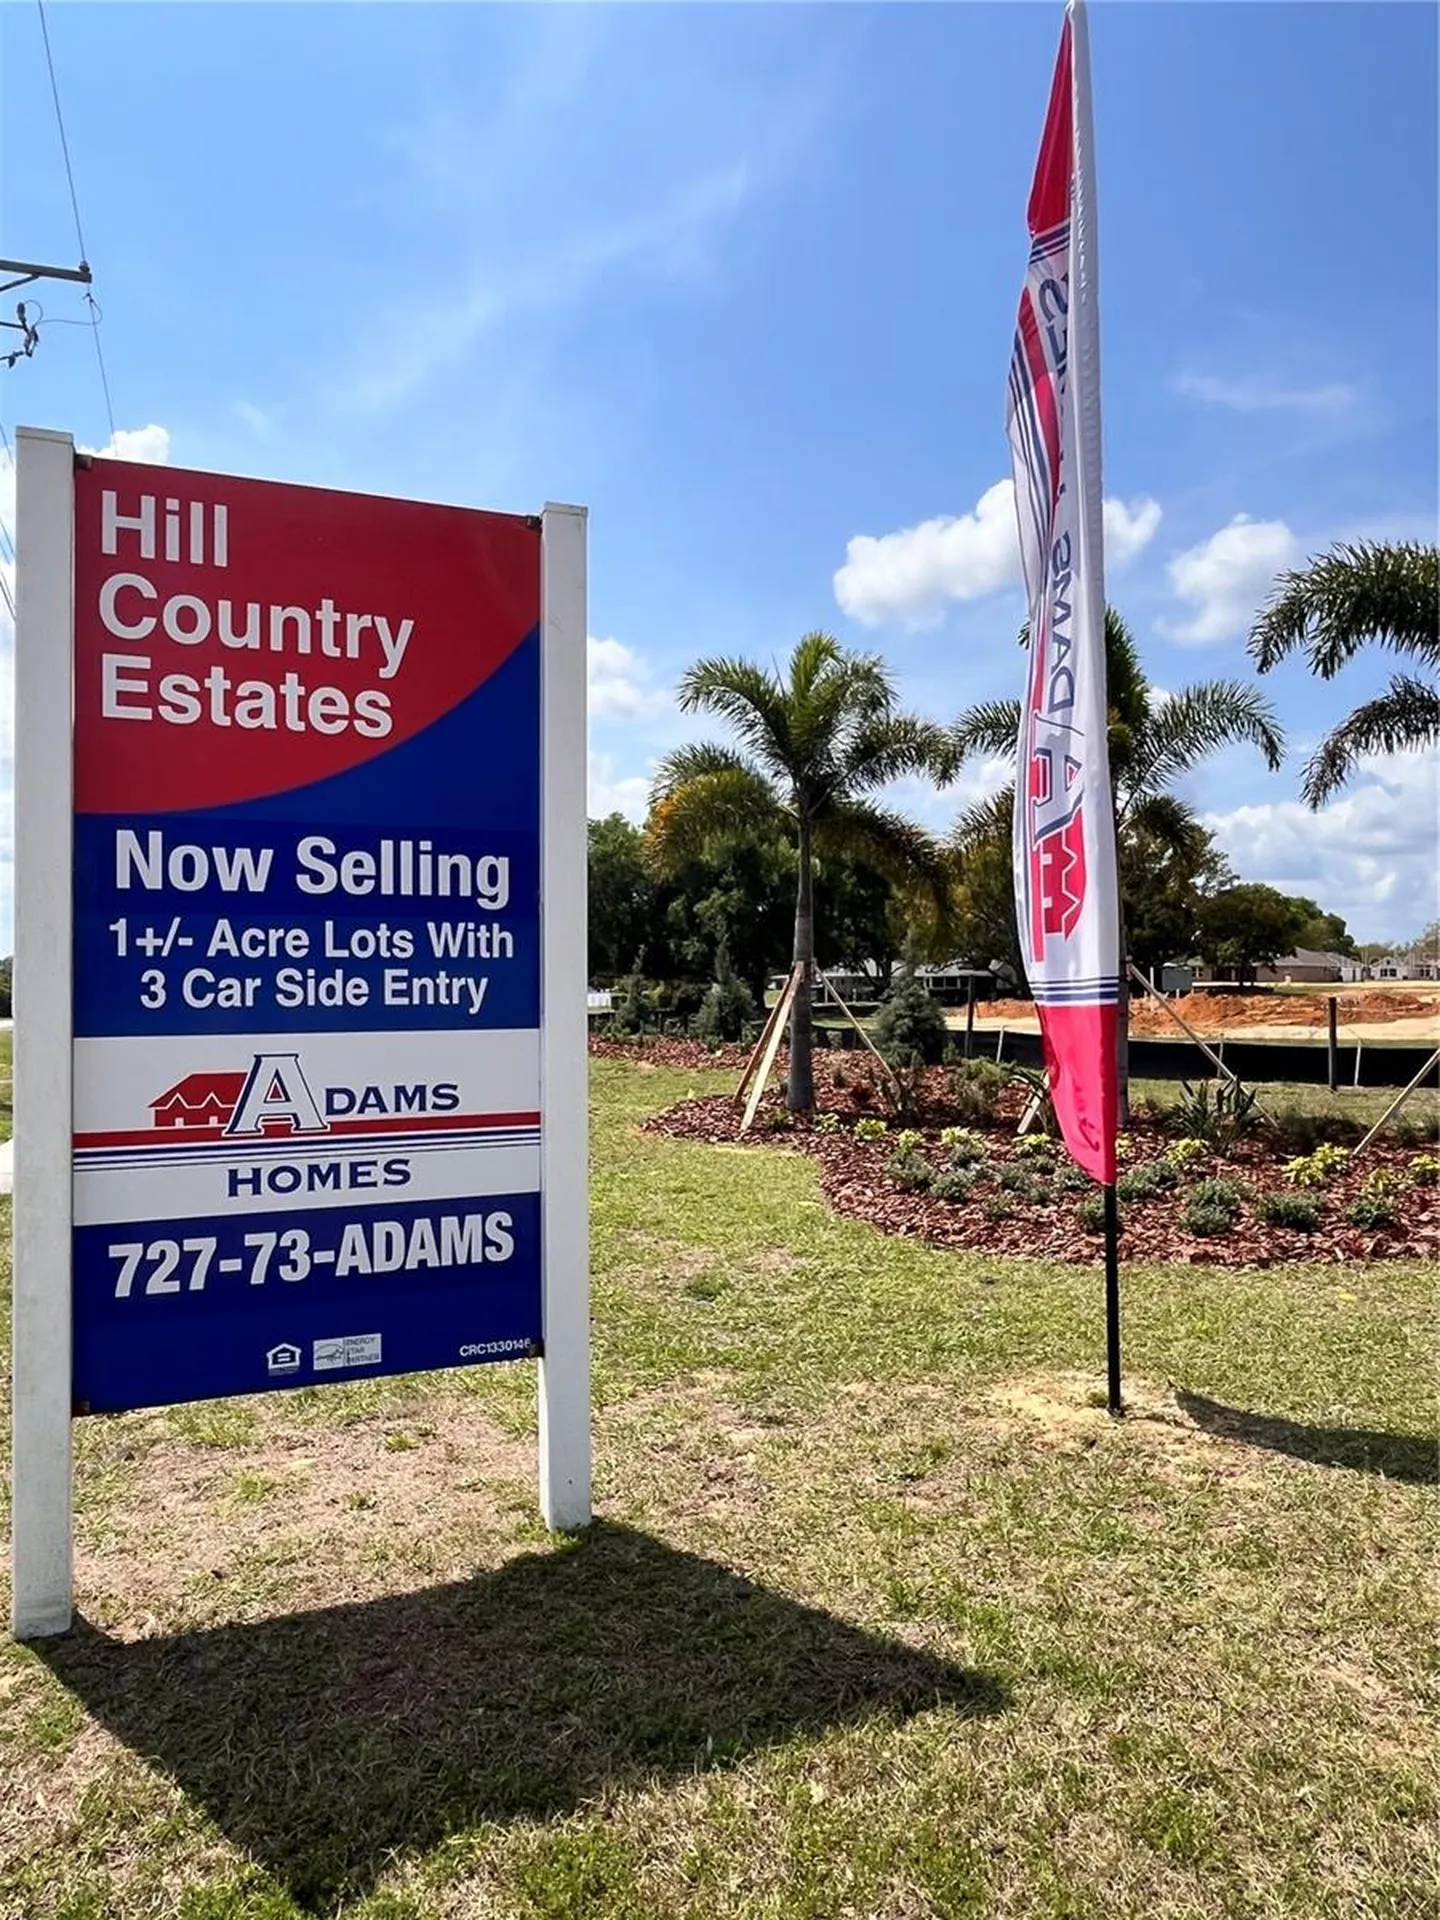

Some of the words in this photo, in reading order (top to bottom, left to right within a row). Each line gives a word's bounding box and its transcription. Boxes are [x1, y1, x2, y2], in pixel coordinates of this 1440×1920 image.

[101, 489, 228, 567] Hill
[99, 572, 415, 679] Country
[101, 653, 394, 739] Estates
[115, 829, 274, 893] Now
[295, 836, 510, 910] Selling
[108, 916, 193, 958] 1+/-
[206, 918, 310, 958] Acre
[324, 920, 415, 959] Lots
[427, 921, 514, 959] With
[140, 969, 167, 1009] 3
[182, 967, 262, 1008] Car
[275, 967, 370, 1007] Side
[384, 968, 489, 1014] Entry
[223, 1052, 461, 1136] ADAMS
[227, 1158, 412, 1198] HOMES
[108, 1211, 514, 1299] 727-73-ADAMS
